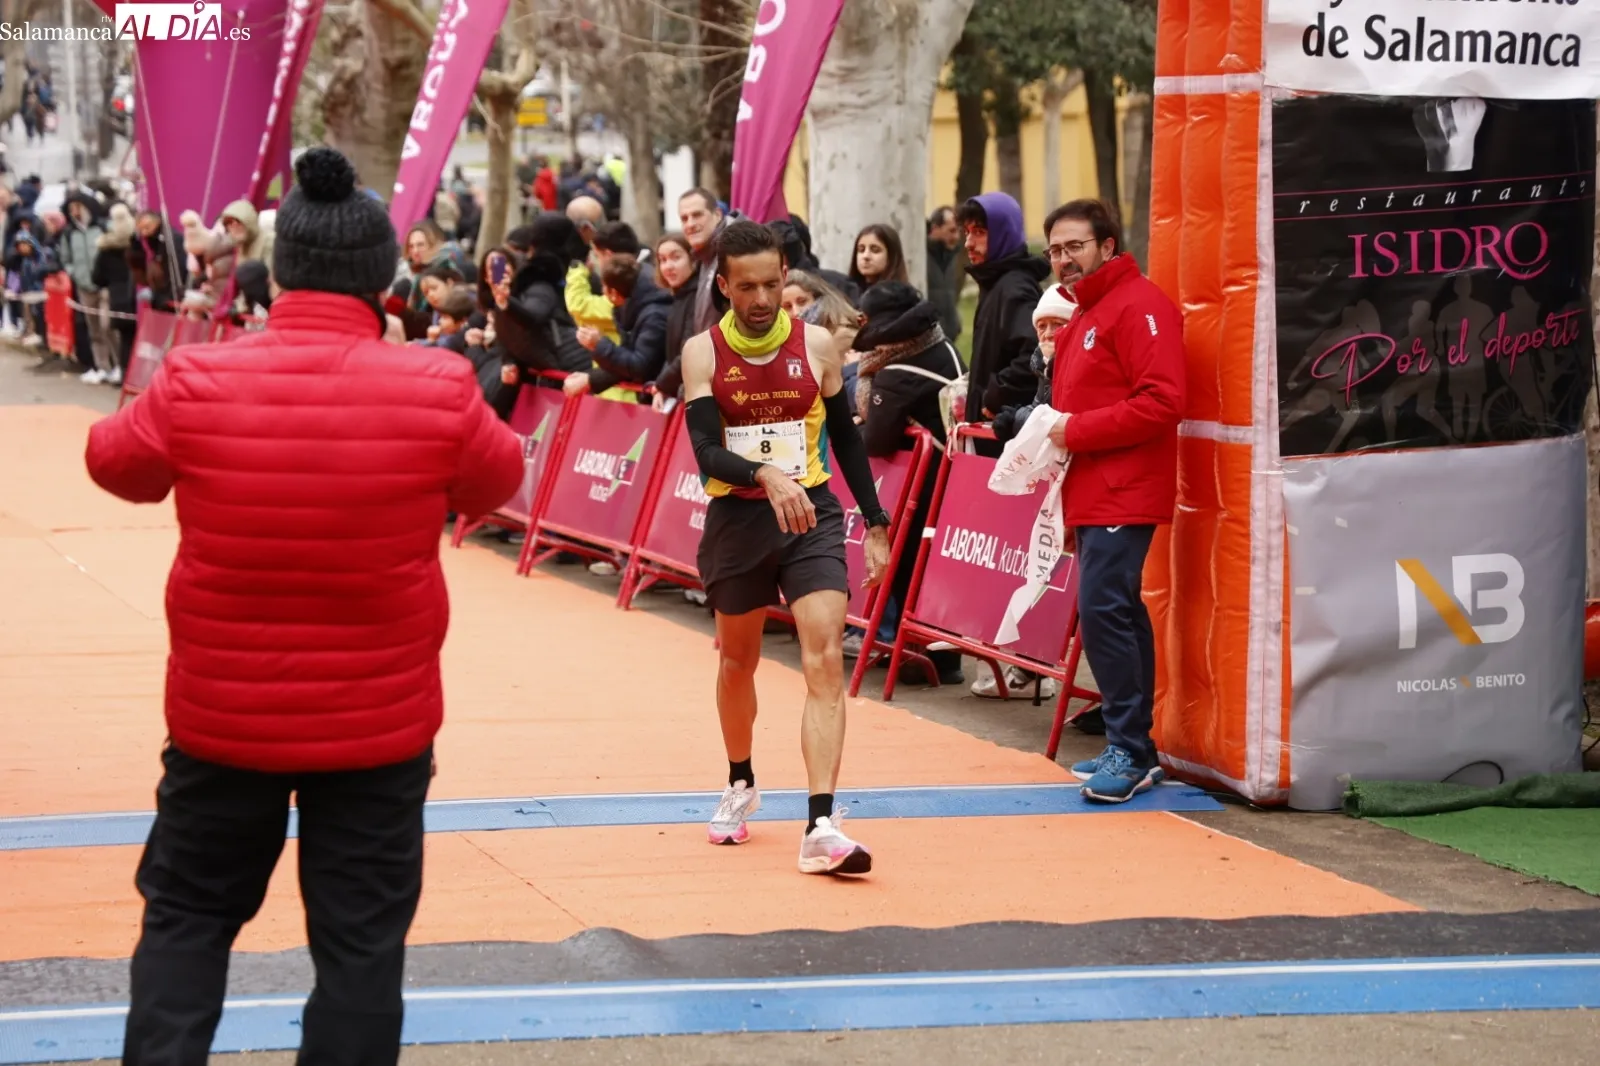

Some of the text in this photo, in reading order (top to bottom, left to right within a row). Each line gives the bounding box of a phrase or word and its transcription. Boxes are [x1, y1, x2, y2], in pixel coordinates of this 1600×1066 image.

[1302, 12, 1582, 67] de Salamanca
[1299, 180, 1586, 214] restaurante
[1348, 221, 1552, 281] ISIDRO
[1311, 307, 1588, 406] Por el deporte
[750, 405, 783, 417] VINO
[772, 390, 801, 399] RURAL
[760, 440, 772, 454] 8
[941, 524, 999, 571] LABORAL
[1396, 672, 1526, 693] NICOLAS BENITO
